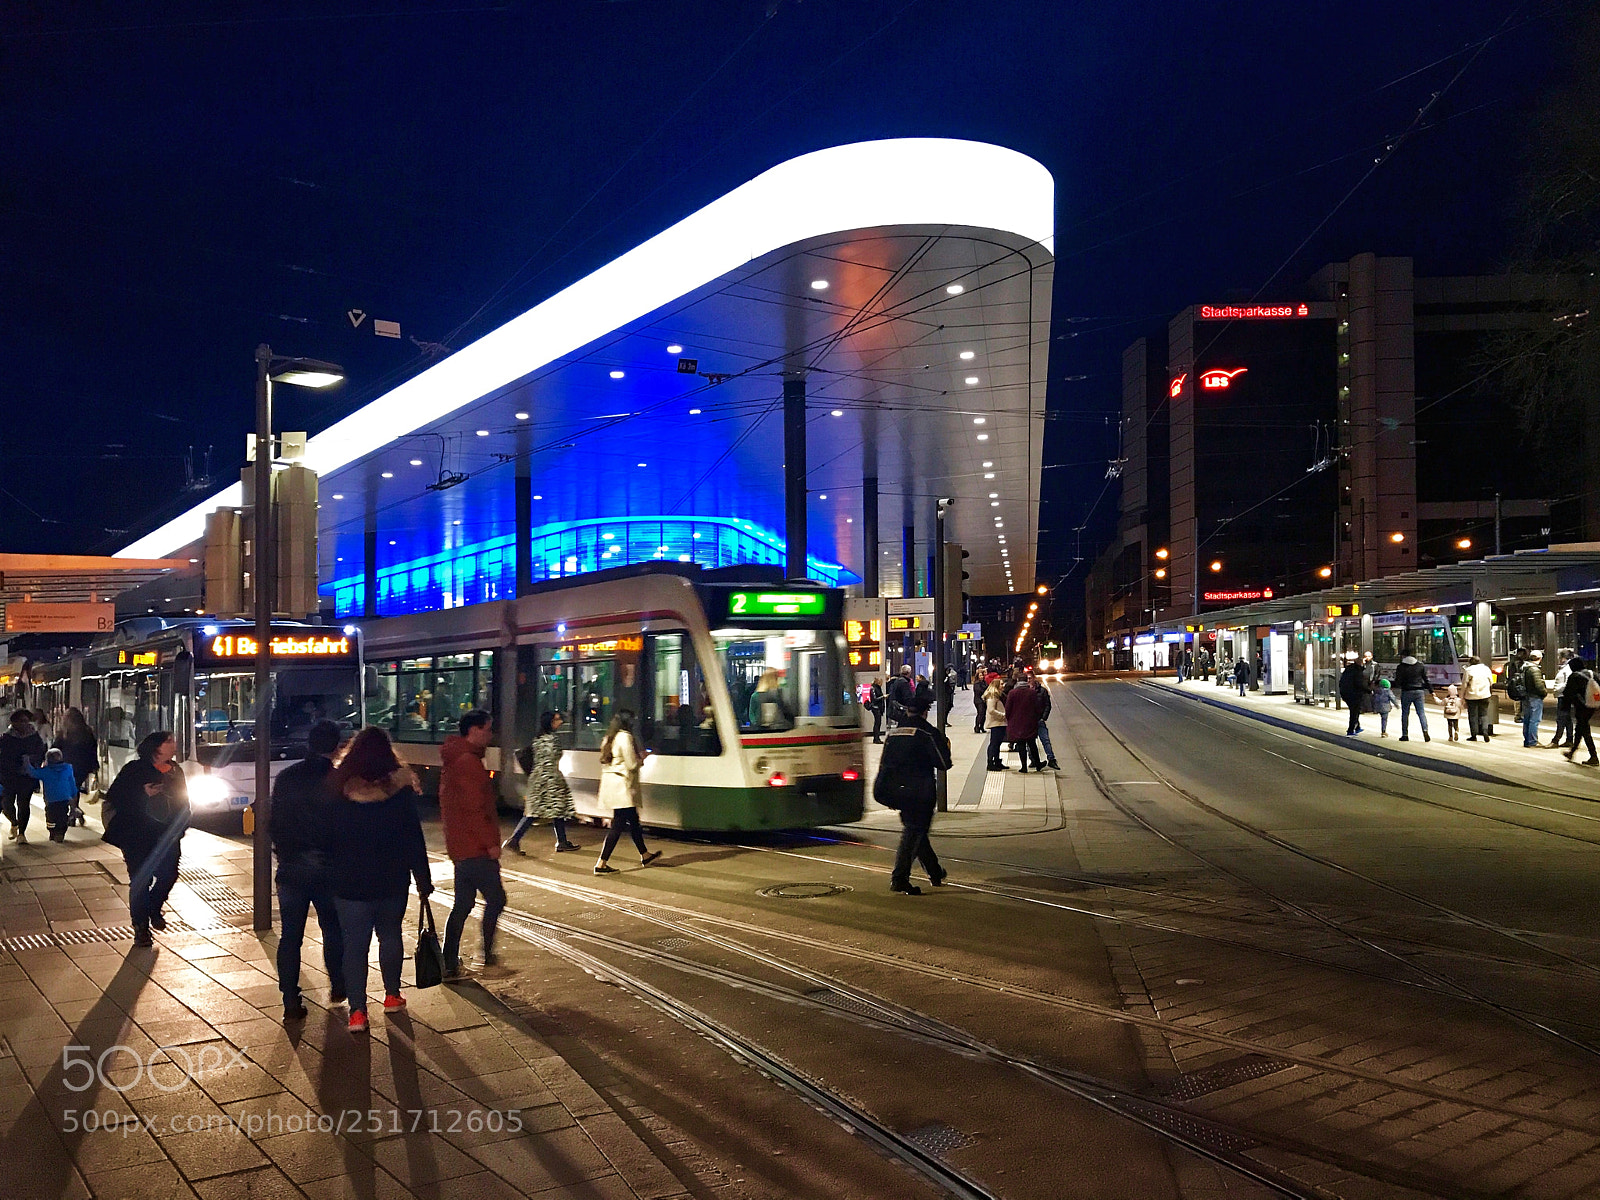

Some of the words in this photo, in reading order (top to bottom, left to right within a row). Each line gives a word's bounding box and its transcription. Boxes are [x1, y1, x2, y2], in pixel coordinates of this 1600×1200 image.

[1201, 305, 1292, 319] Stadtsparkasse
[1205, 377, 1229, 387] LBS
[732, 593, 747, 613] 2
[1204, 592, 1261, 600] Stadtsparkasse
[97, 616, 114, 630] B2
[212, 635, 233, 656] 41
[237, 636, 348, 655] Beiebsfahrt
